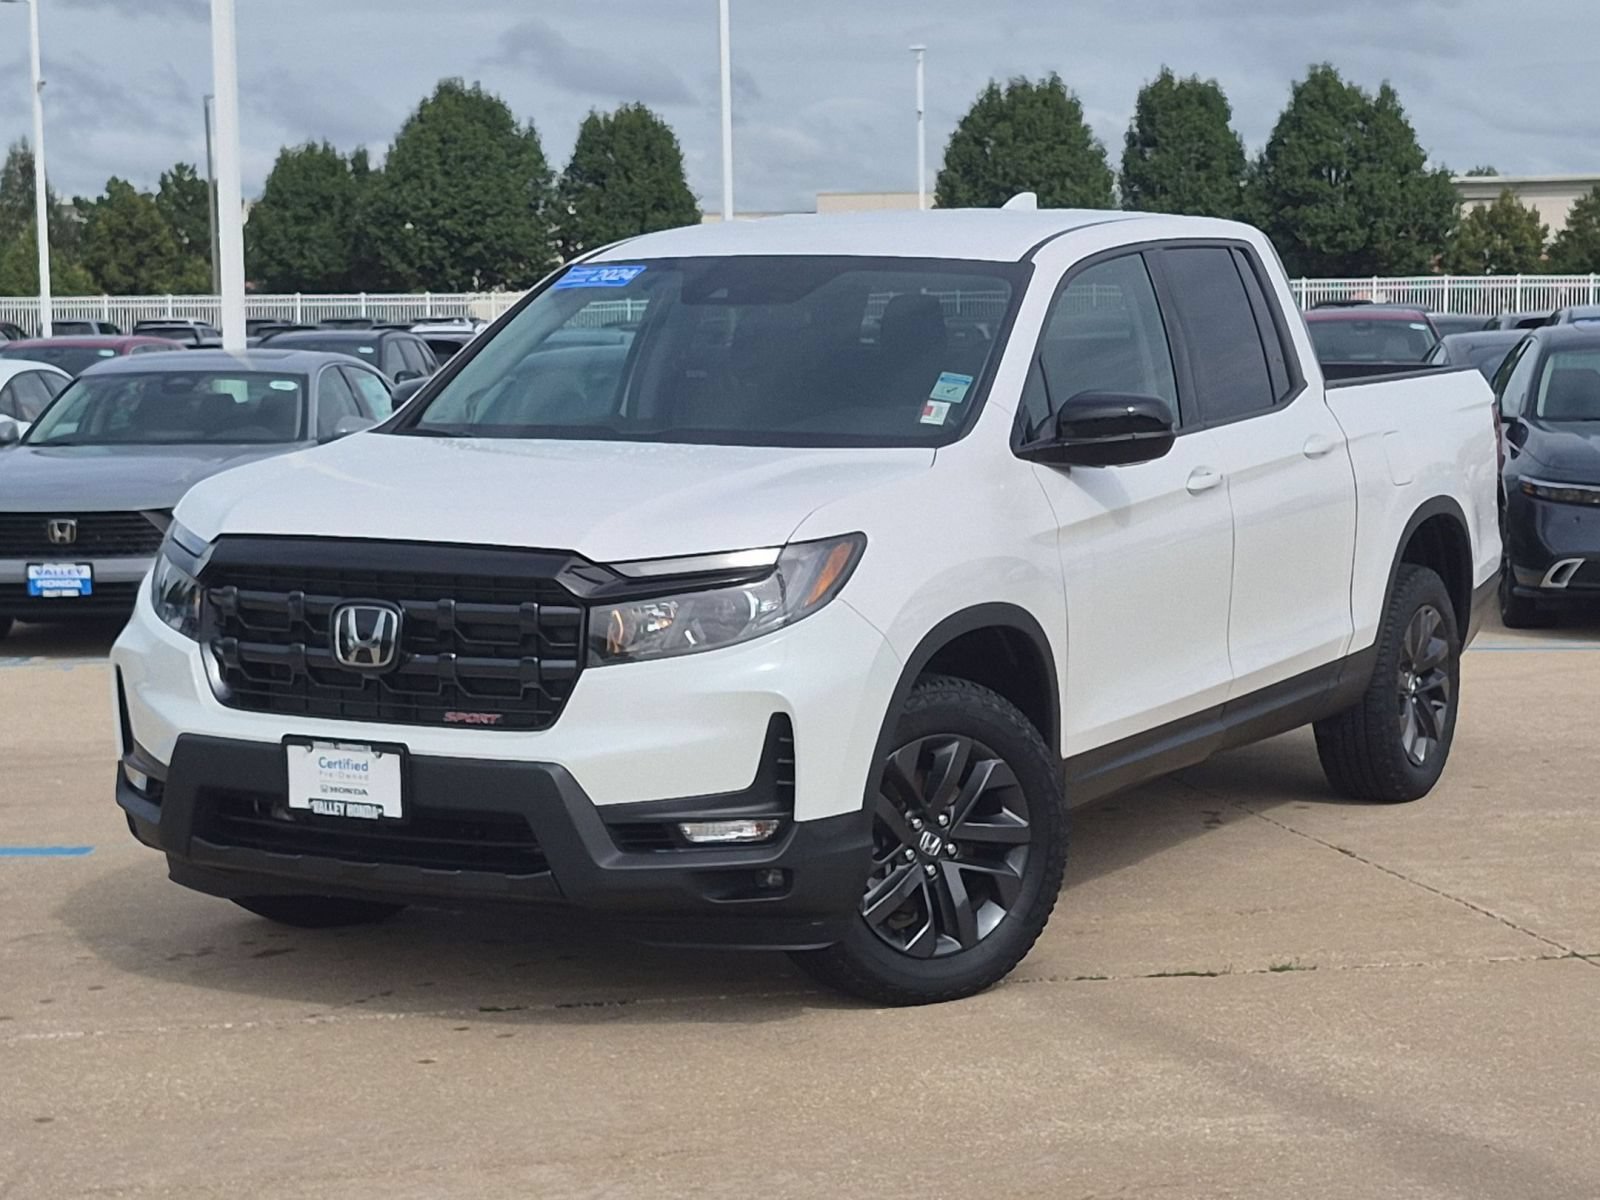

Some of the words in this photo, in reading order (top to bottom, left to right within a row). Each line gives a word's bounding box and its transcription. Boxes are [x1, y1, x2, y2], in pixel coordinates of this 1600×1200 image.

[589, 269, 639, 281] 2024
[34, 568, 84, 577] VALLEY
[443, 711, 503, 725] SPORT
[318, 756, 369, 772] Certified
[330, 786, 368, 796] HONDA
